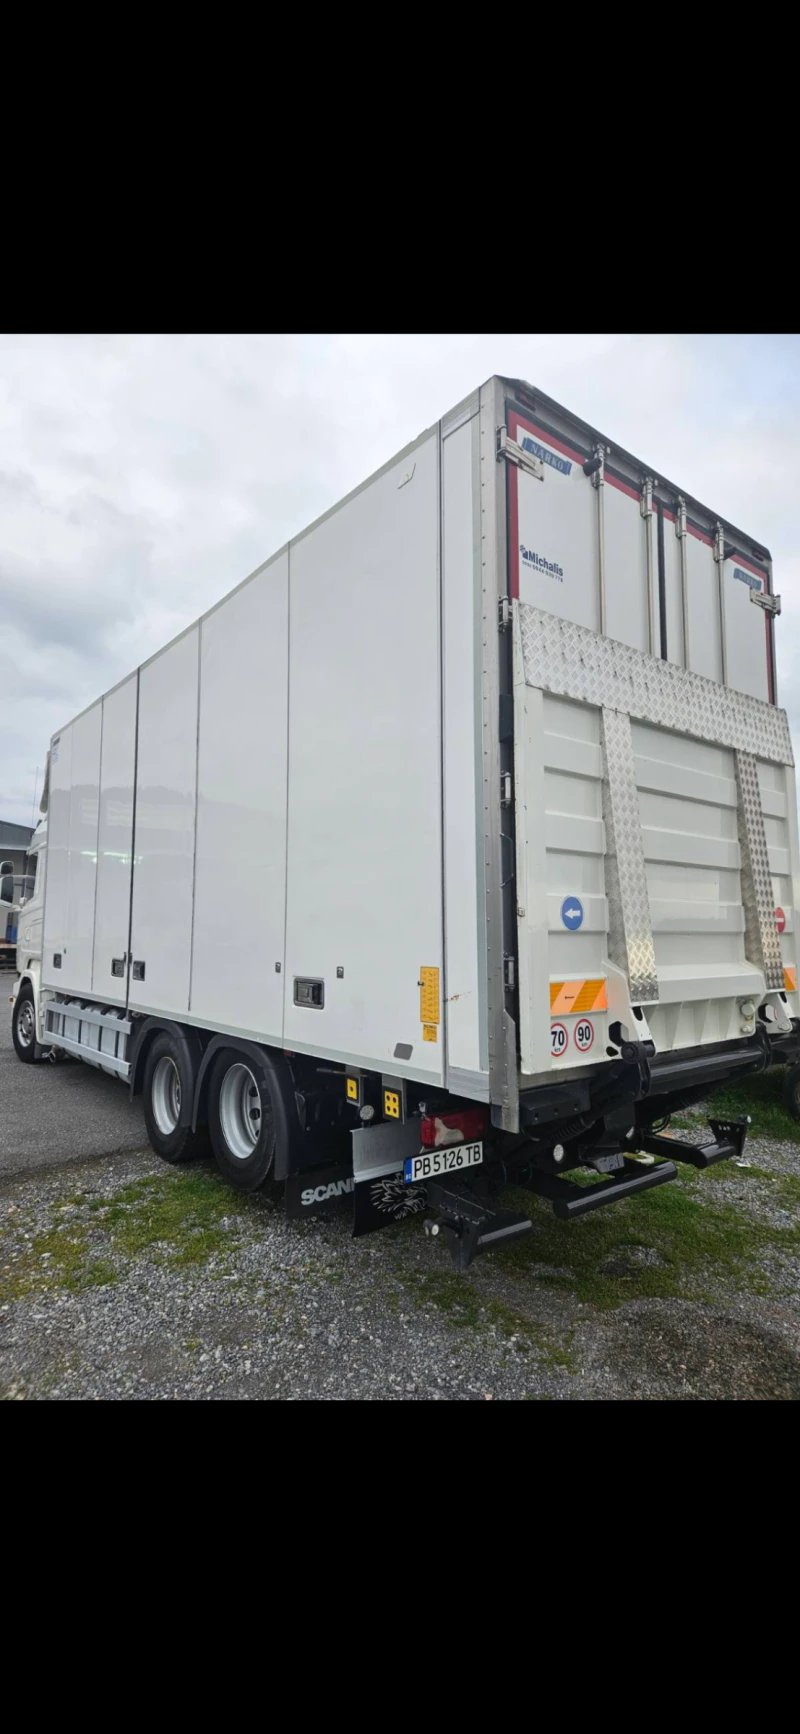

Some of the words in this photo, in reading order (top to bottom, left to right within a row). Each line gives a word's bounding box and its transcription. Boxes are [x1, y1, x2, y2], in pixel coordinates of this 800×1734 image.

[530, 443, 564, 471] NARKO
[529, 550, 564, 577] Michalis
[551, 1030, 565, 1047] 70
[578, 1025, 591, 1042] 90
[414, 1157, 431, 1178] PB
[433, 1148, 464, 1173] 5126
[466, 1144, 481, 1164] TB
[301, 1177, 355, 1206] SCANI
